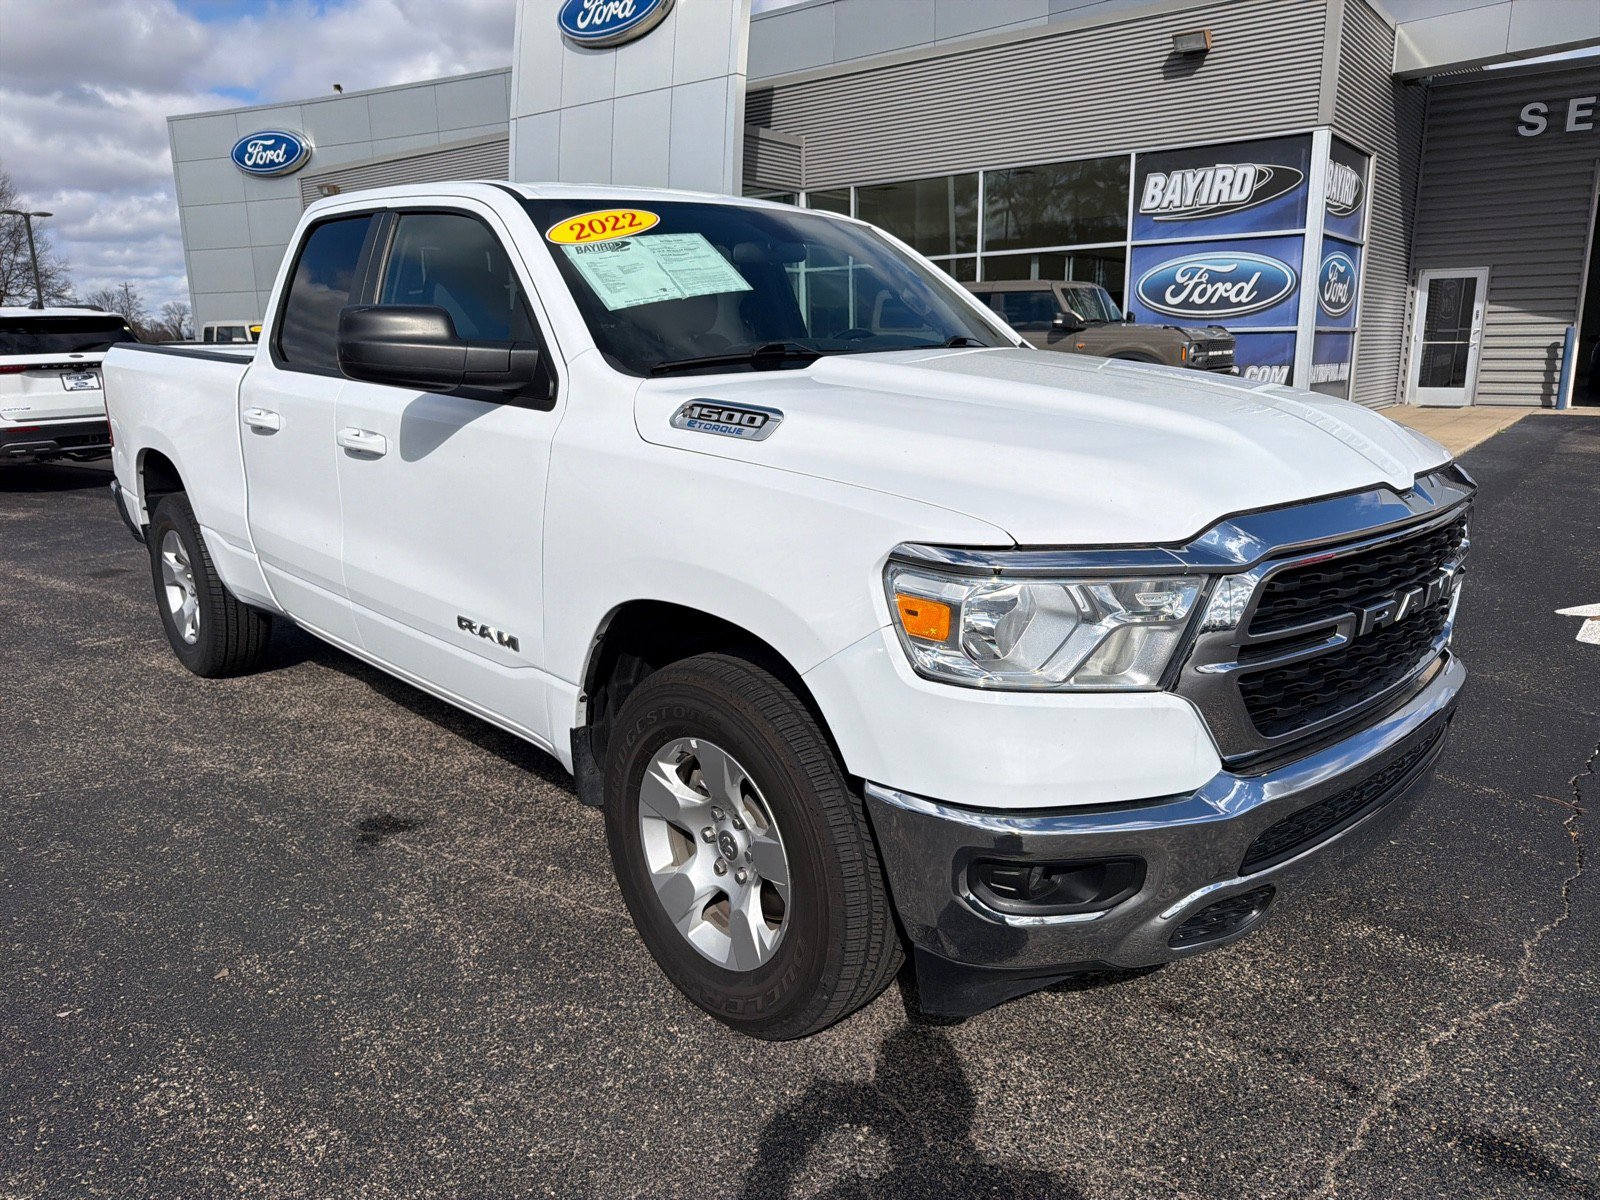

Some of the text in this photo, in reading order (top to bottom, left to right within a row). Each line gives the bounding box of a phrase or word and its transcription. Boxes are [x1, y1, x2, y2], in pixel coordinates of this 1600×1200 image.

[577, 0, 637, 29] Ford
[244, 139, 287, 166] Ford
[1140, 163, 1258, 213] BAYIRD
[1326, 159, 1358, 209] BAYIRD
[569, 212, 642, 241] 2022
[574, 242, 616, 255] BAYIRD
[1164, 262, 1262, 306] Ford
[1324, 261, 1351, 304] Ford
[685, 406, 766, 428] 1500
[1359, 574, 1452, 637] RAM
[457, 614, 520, 653] RAM
